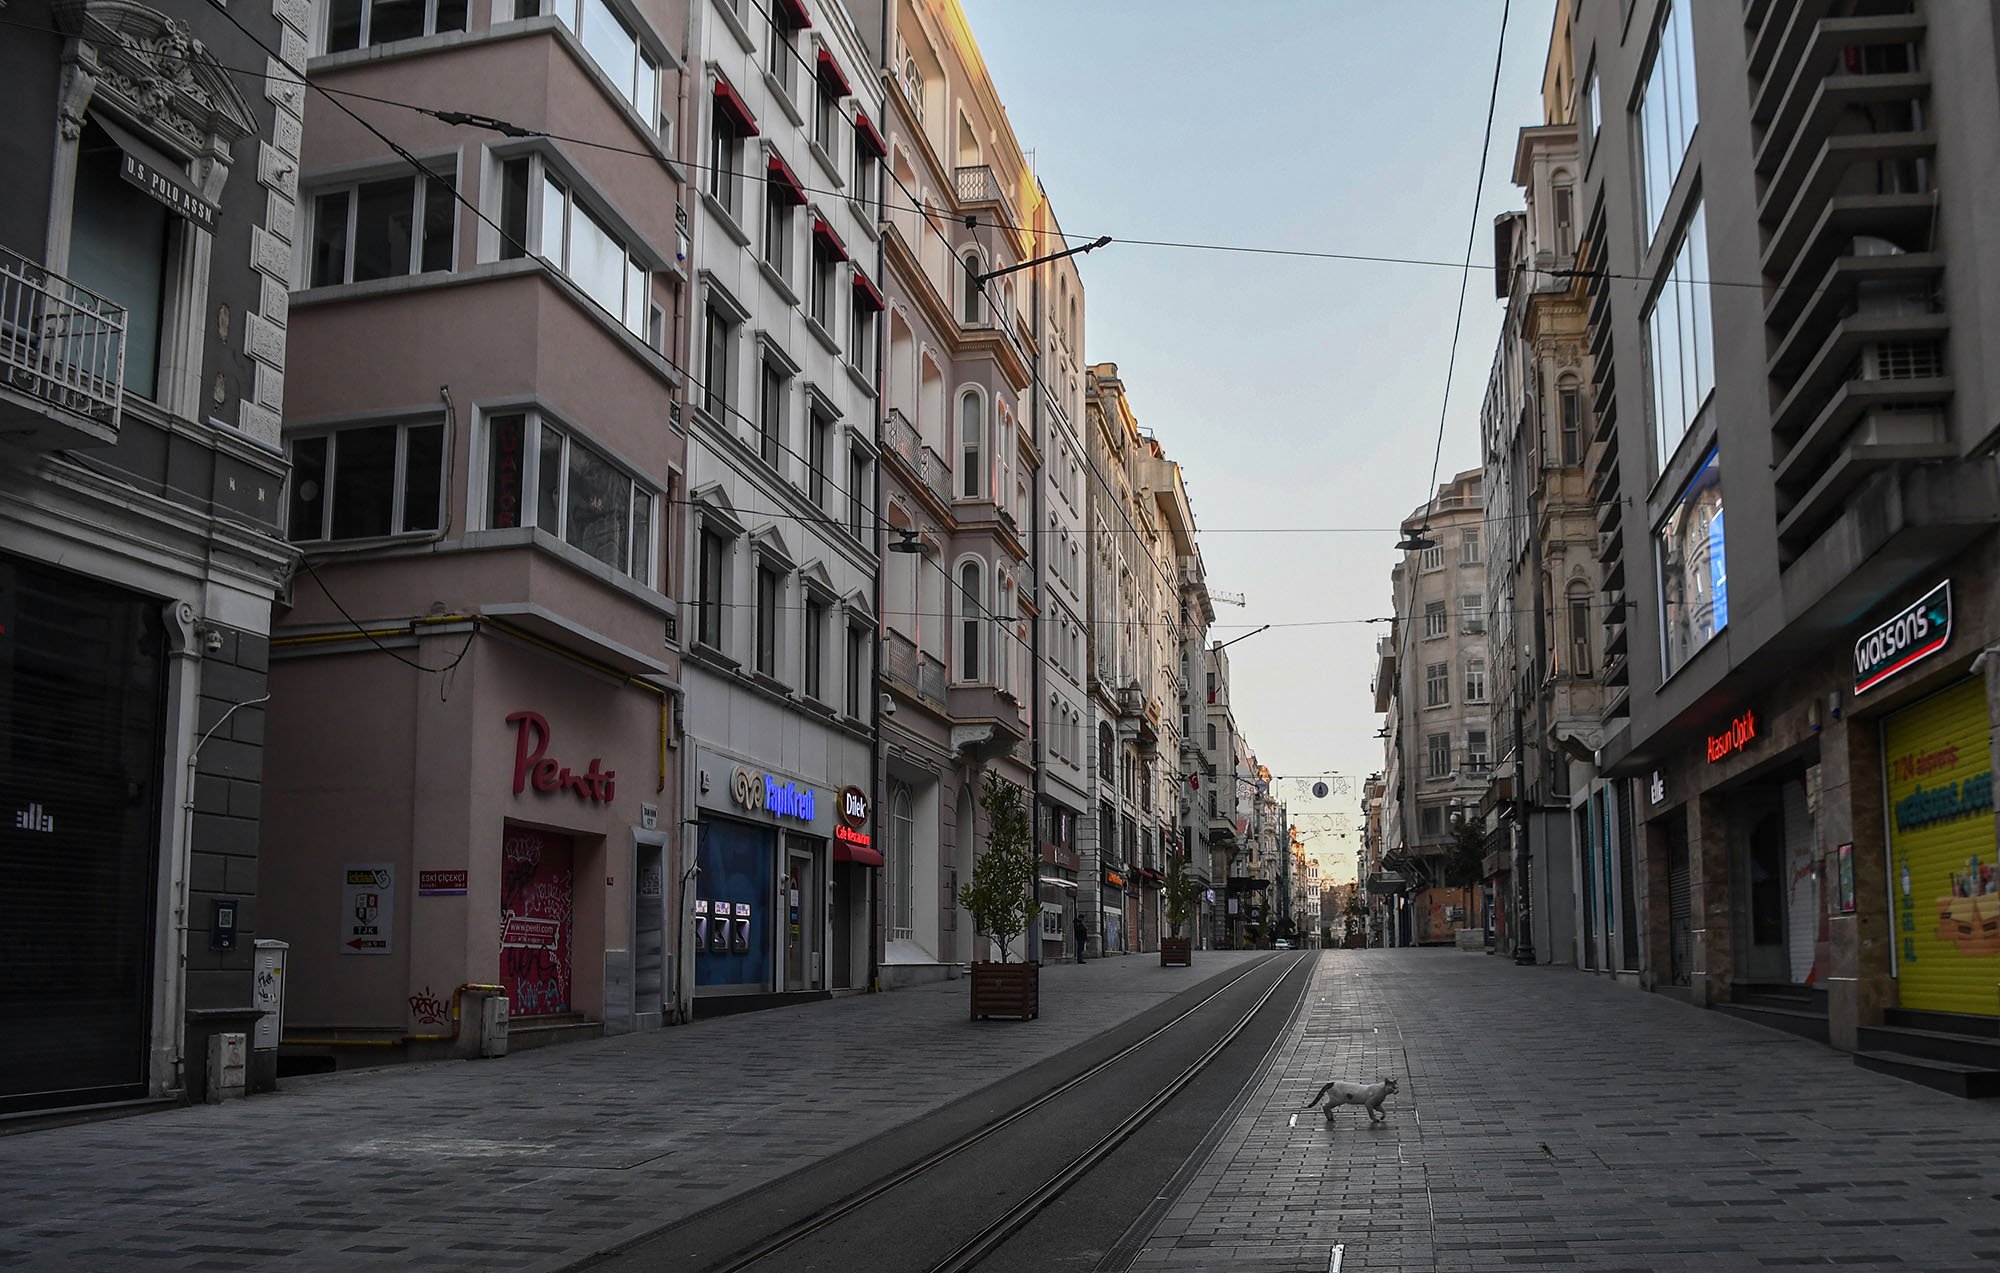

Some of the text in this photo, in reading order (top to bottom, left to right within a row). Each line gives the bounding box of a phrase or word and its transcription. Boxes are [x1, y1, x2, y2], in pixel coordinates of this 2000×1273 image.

[127, 156, 214, 226] U.S. POLO ASSN.
[1855, 604, 1929, 674] watsons
[505, 711, 616, 803] Penti
[1707, 708, 1755, 765] Atasun Optik
[846, 792, 867, 819] Dilek
